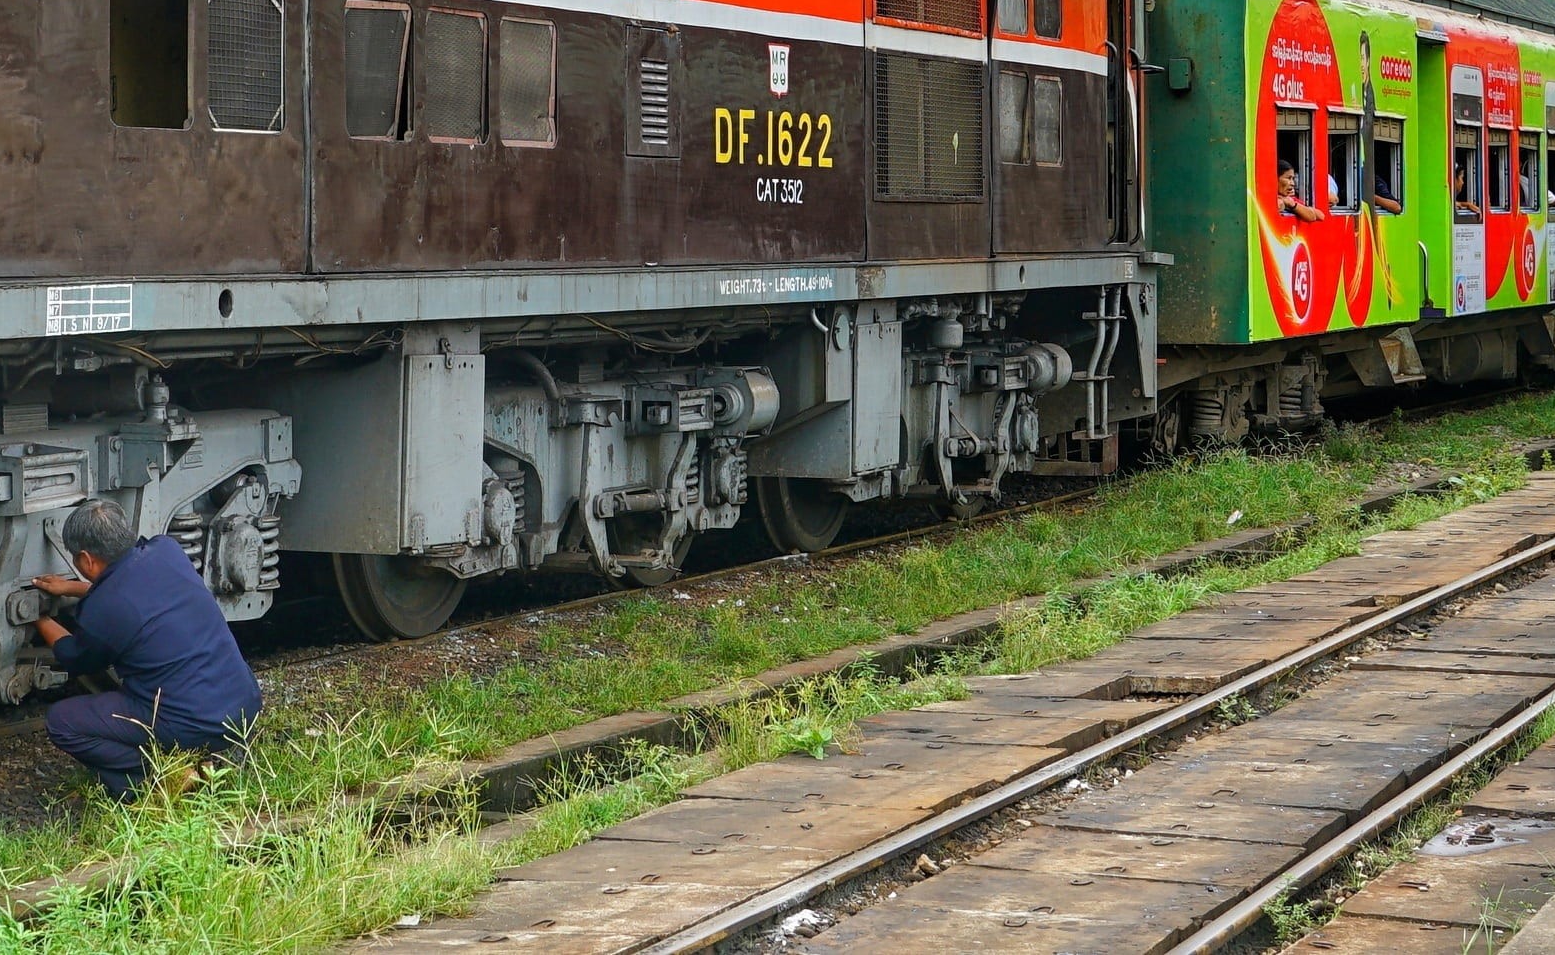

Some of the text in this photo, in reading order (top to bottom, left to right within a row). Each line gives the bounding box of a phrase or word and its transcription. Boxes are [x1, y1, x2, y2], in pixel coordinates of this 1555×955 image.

[772, 50, 786, 66] MR
[1381, 58, 1412, 79] ooredoo
[1273, 73, 1304, 102] 4G plus
[715, 108, 833, 168] DF.1622
[756, 178, 803, 203] CAT 3512
